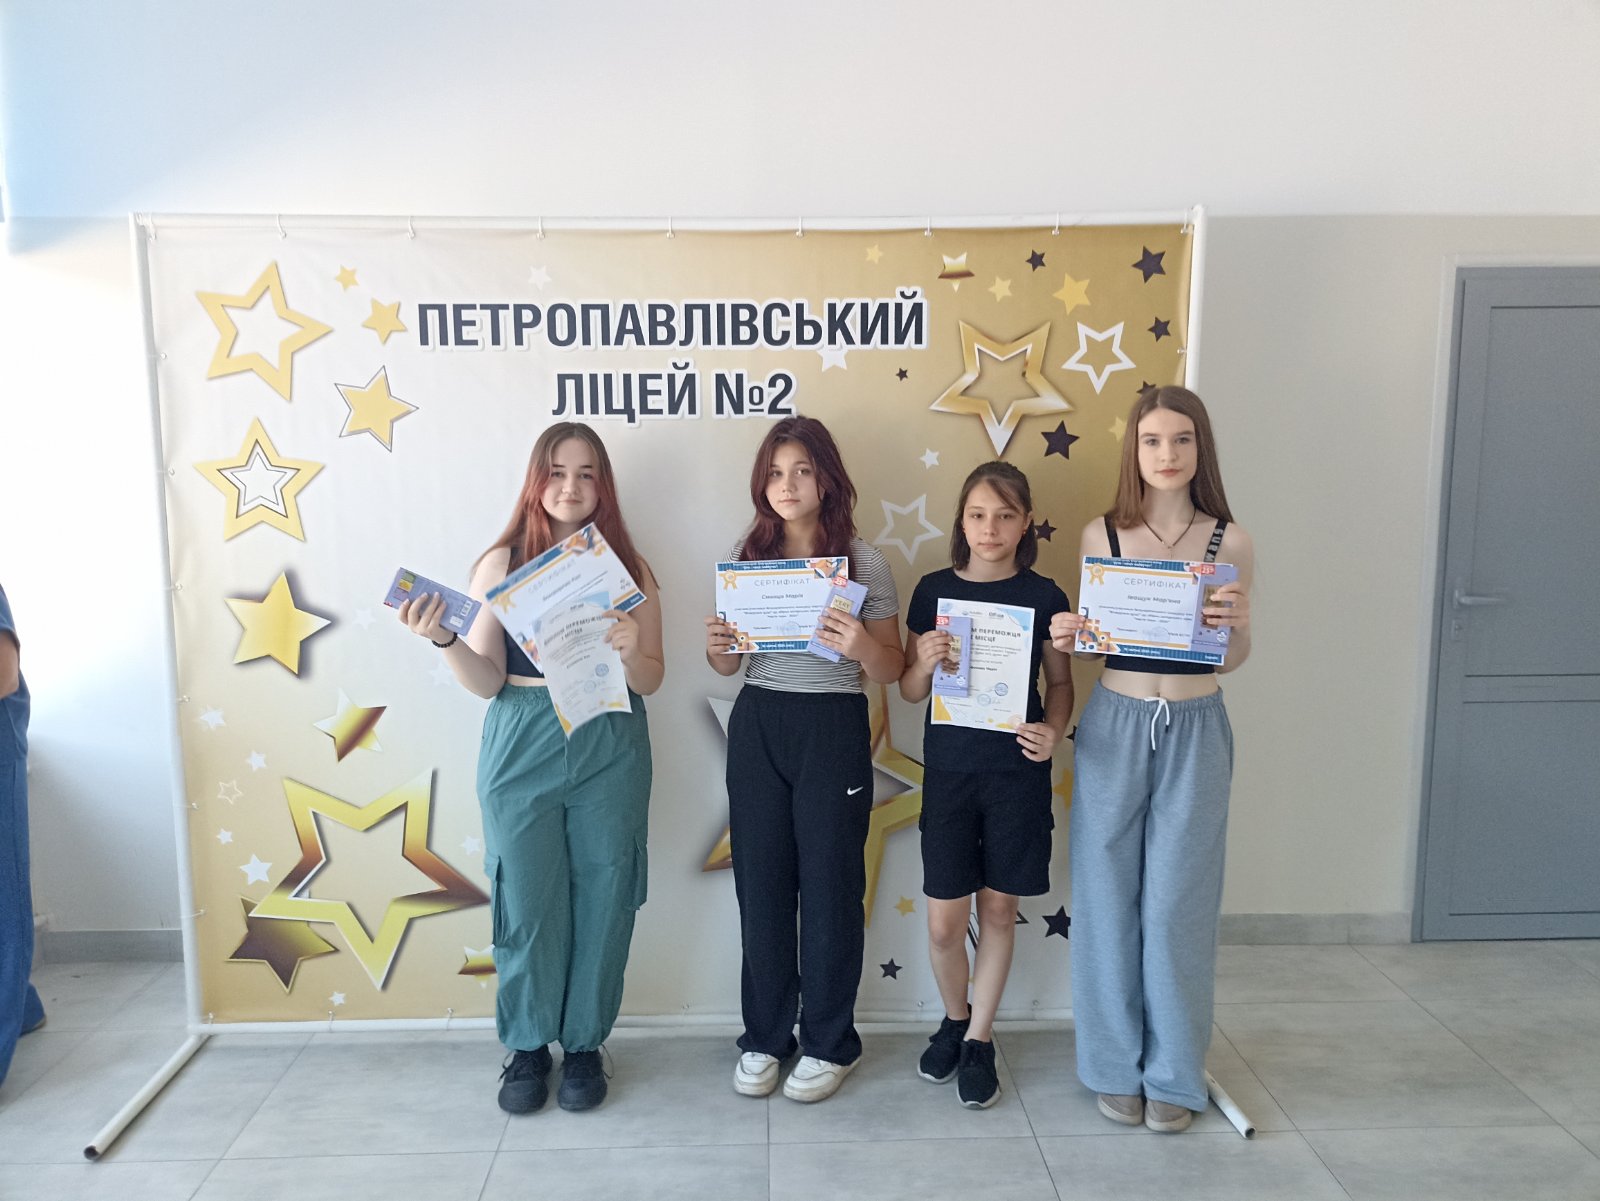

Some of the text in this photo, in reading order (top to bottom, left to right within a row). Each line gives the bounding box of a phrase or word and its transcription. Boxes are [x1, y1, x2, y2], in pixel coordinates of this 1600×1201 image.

[417, 290, 925, 347] ПЕТРОПАВЛІВСЬКИЙ
[552, 361, 794, 423] ЛІЦЕЙ №2
[754, 577, 811, 587] СЕРТИФІКАТ
[1123, 577, 1188, 590] СЕРТИФІКАТ
[978, 627, 1021, 638] ПЕРЕМОЖЦЯ
